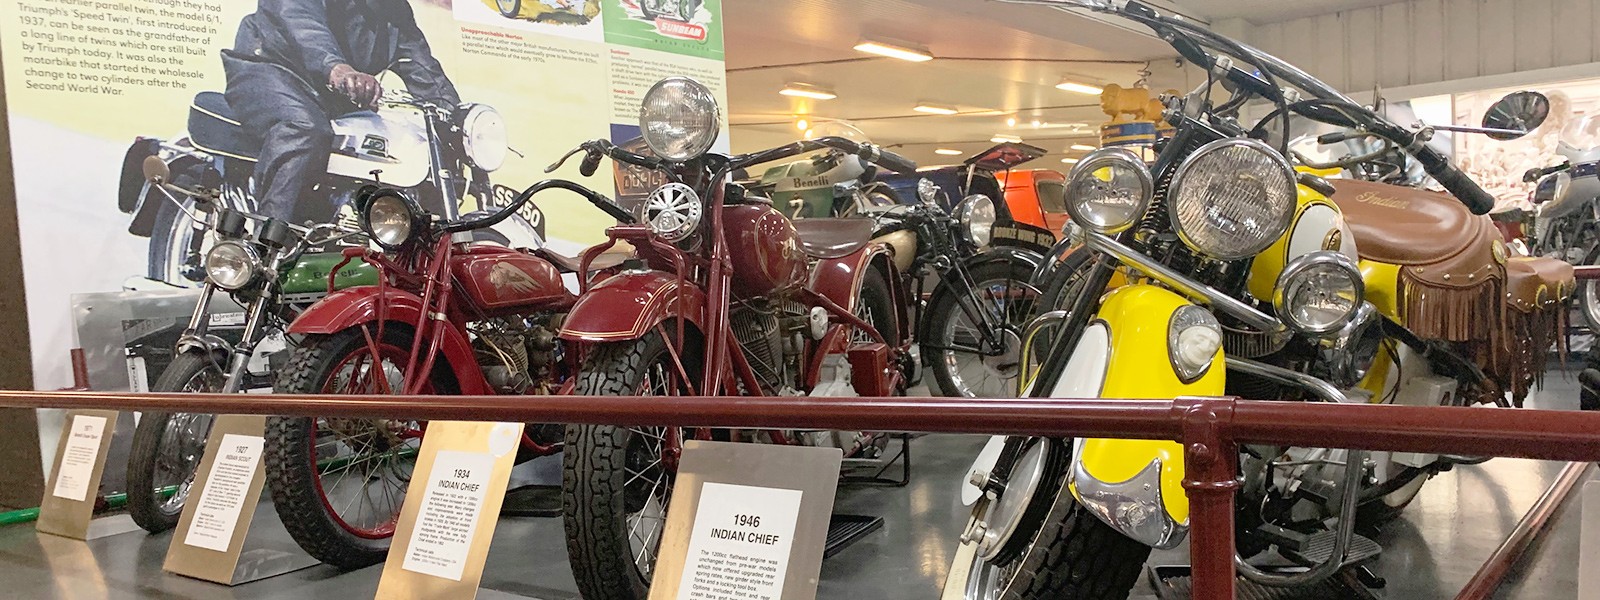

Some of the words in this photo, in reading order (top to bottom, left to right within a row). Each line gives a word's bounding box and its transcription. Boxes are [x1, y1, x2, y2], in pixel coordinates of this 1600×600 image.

[95, 1, 132, 12] parallel
[135, 6, 157, 16] twin,
[160, 8, 174, 17] the
[177, 12, 204, 21] model
[183, 1, 202, 11] they
[204, 3, 222, 12] had
[18, 2, 68, 17] Triumph's
[136, 16, 155, 27] first
[158, 20, 206, 33] introduced
[209, 26, 216, 34] in
[19, 16, 47, 27] 1937,
[72, 21, 83, 30] be
[87, 25, 109, 33] seen
[126, 29, 141, 37] the
[144, 32, 199, 43] grandfather
[661, 22, 702, 37] SUNBEAM
[31, 29, 54, 42] long
[57, 32, 75, 41] line
[90, 37, 117, 46] twins
[120, 41, 147, 49] which
[186, 47, 206, 56] built
[22, 41, 34, 52] by
[37, 42, 80, 55] Triumph
[83, 48, 114, 60] today.
[117, 51, 123, 59] It
[148, 55, 166, 63] also
[169, 56, 183, 65] the
[24, 56, 77, 67] motorbike
[80, 60, 100, 69] that
[104, 63, 138, 73] started
[141, 66, 156, 74] the
[159, 68, 204, 79] wholesale
[25, 67, 64, 80] change
[80, 73, 98, 81] two
[101, 75, 144, 85] cylinders
[147, 78, 169, 87] after
[172, 80, 186, 88] the
[26, 80, 65, 91] Second
[67, 83, 98, 93] World
[101, 86, 124, 96] War.
[793, 176, 829, 188] Benelli
[1356, 191, 1410, 209] Indian
[454, 469, 470, 478] 1934
[438, 480, 460, 490] INDIAN
[460, 483, 480, 492] CHIEF
[734, 514, 760, 528] 1946
[711, 528, 745, 541] INDIAN
[748, 532, 779, 546] CHIEF
